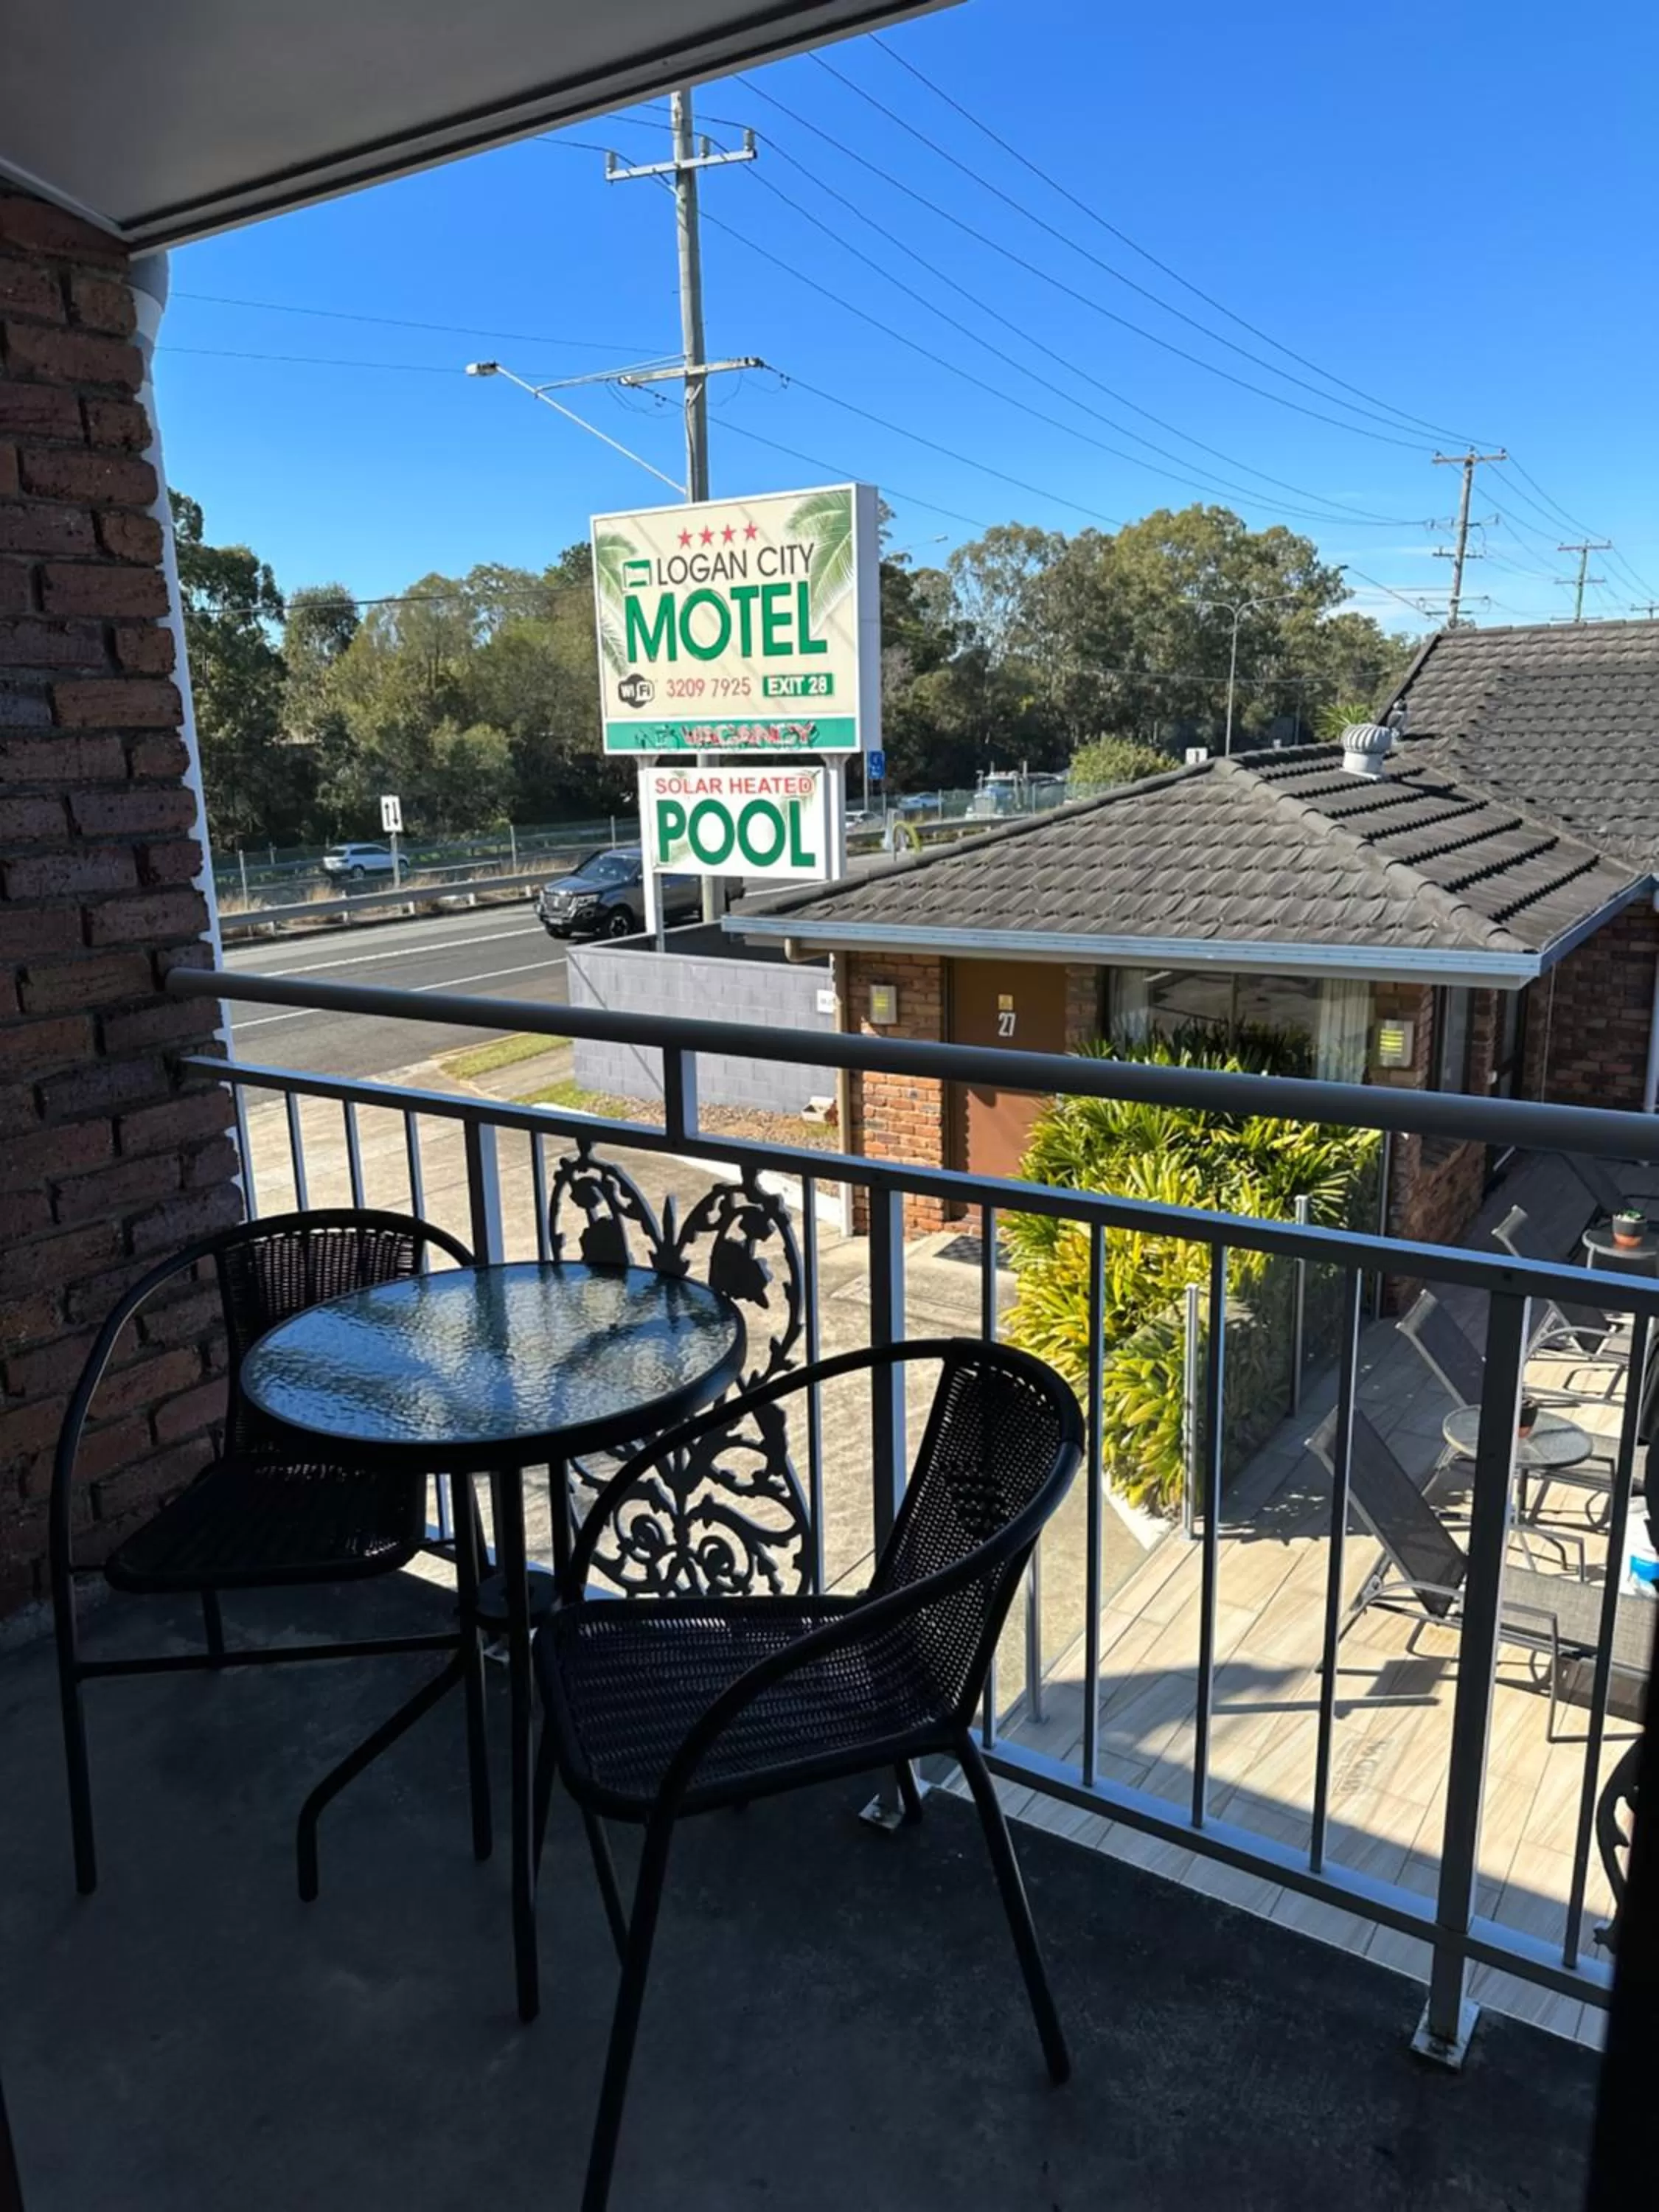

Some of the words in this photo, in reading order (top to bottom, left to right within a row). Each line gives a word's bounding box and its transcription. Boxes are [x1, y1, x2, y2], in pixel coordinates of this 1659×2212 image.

[657, 549, 748, 586] LOGAN
[757, 543, 815, 577] CITY
[624, 580, 828, 664] MOTEL
[666, 678, 706, 698] 3209
[710, 676, 752, 698] 7925
[768, 675, 804, 695] EXIT
[808, 675, 827, 694] 28
[655, 778, 723, 795] SOLAR
[728, 778, 813, 795] HEATED
[655, 799, 816, 868] POOL
[998, 1012, 1016, 1037] 27
